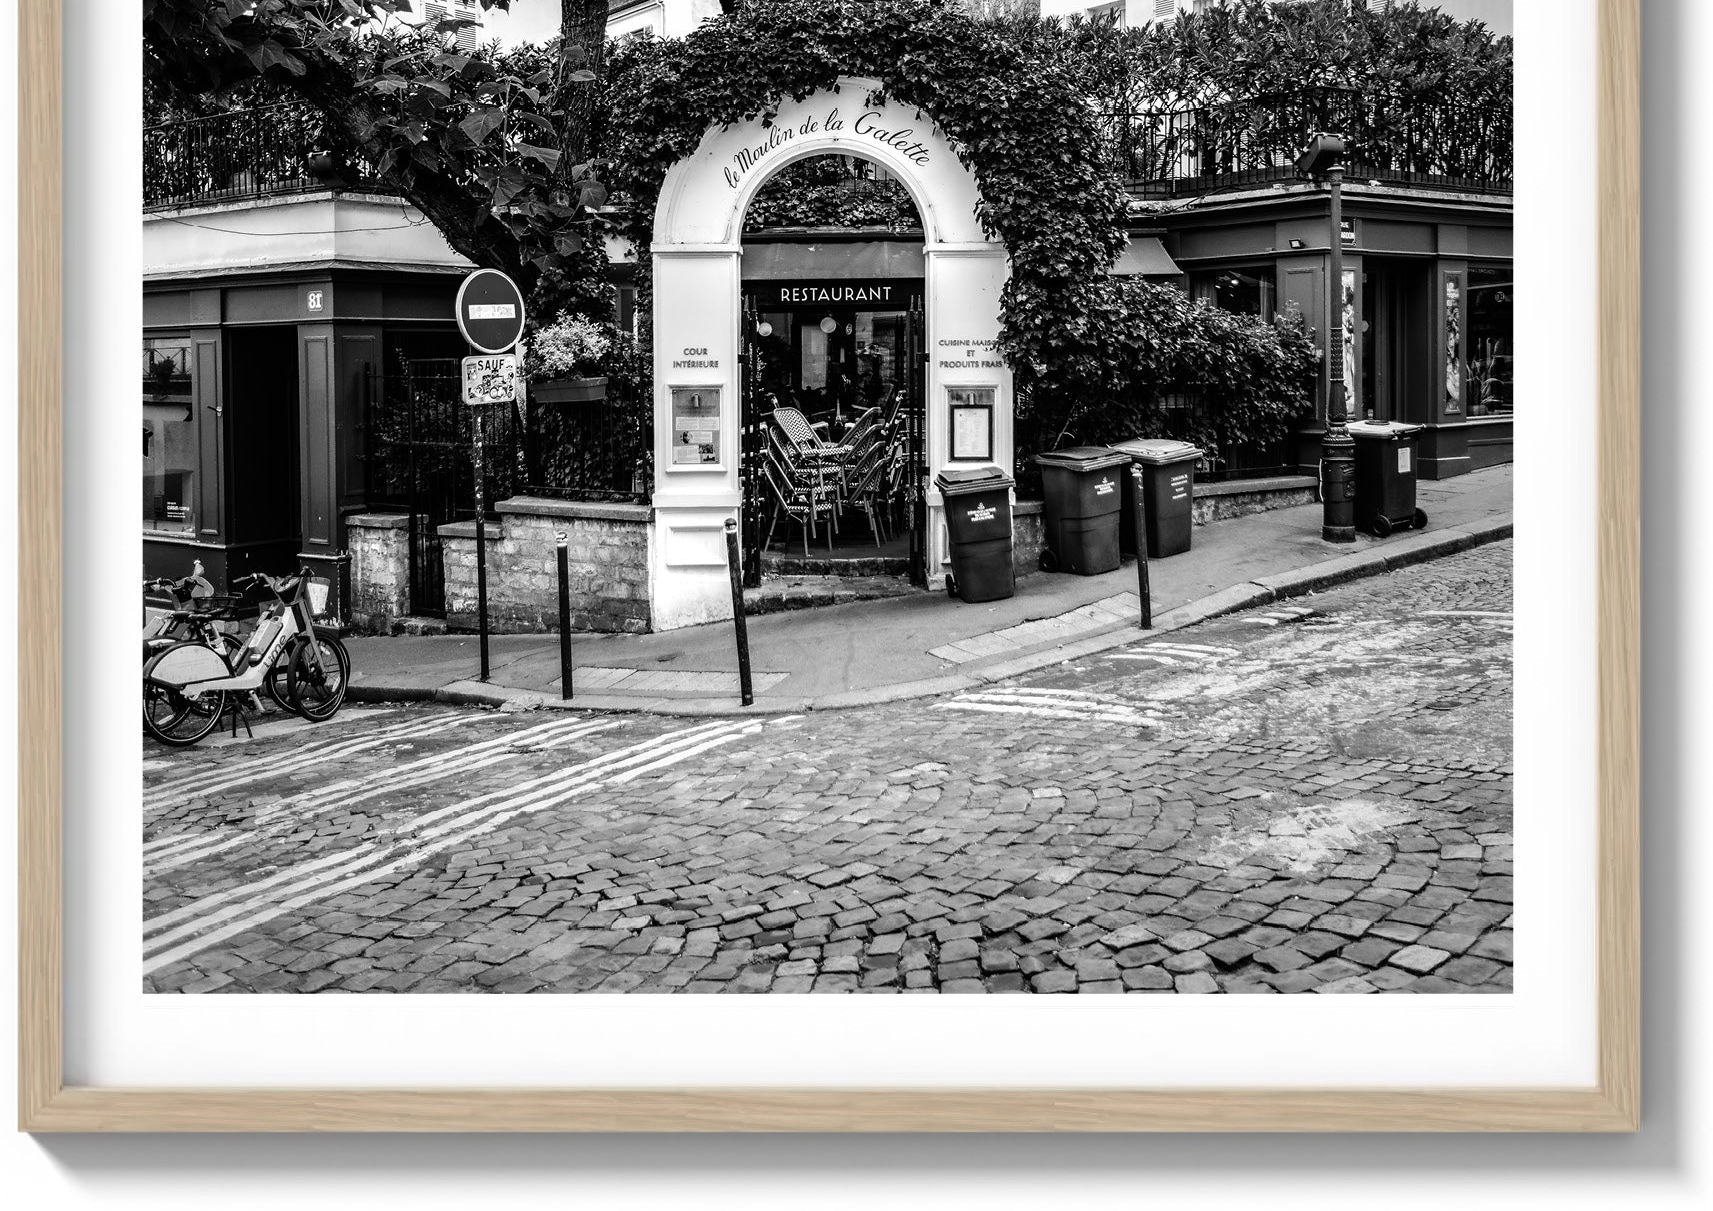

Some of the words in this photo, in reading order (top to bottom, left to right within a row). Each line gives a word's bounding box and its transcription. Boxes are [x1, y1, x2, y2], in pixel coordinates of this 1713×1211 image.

[724, 166, 740, 189] le
[733, 124, 795, 174] Moulin
[799, 115, 818, 135] de
[824, 107, 843, 132] la
[854, 111, 930, 167] Galette
[781, 286, 892, 302] RESTAURANT
[938, 339, 970, 347] CUISINE
[683, 347, 708, 356] COUR
[966, 349, 975, 357] ET
[477, 359, 505, 372] SAUF
[672, 359, 719, 368] INTÉRIEURE
[939, 360, 980, 369] PRODUITS
[981, 360, 1003, 368] FRAIS
[263, 634, 287, 668] Lime
